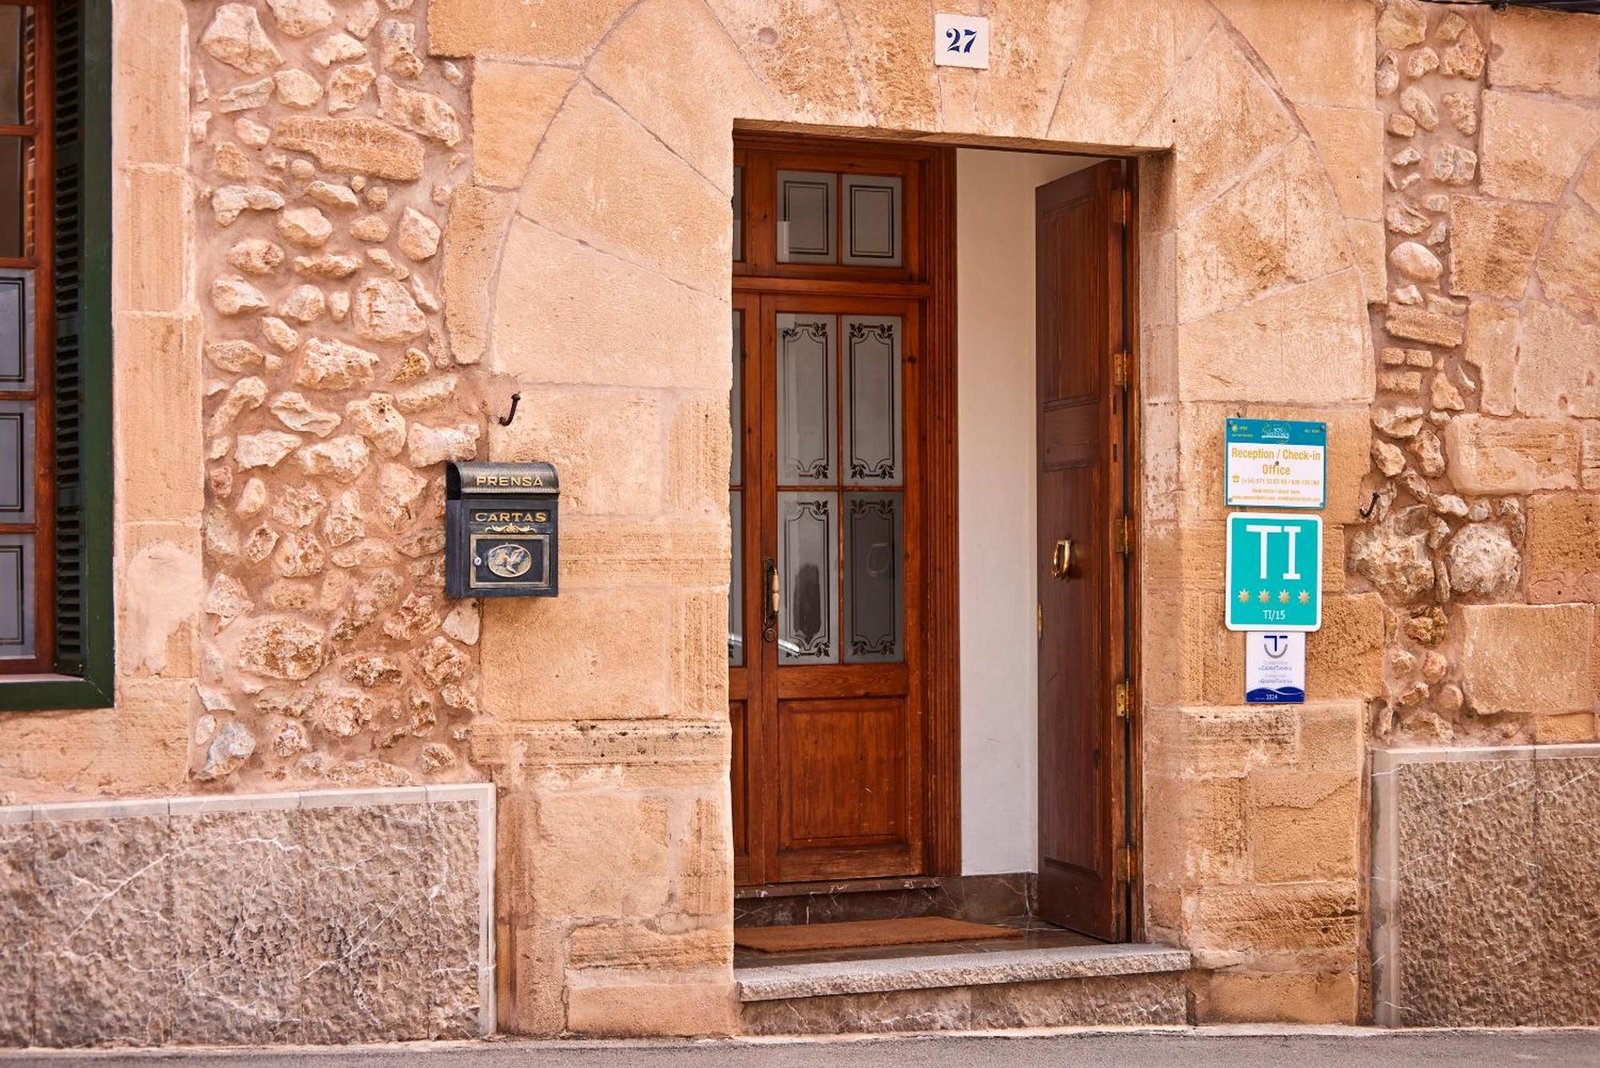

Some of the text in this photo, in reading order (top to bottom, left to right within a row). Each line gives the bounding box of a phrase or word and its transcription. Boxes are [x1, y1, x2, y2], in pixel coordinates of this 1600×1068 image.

[946, 28, 977, 53] 27
[1231, 448, 1321, 461] Reception / Check-in
[1262, 464, 1291, 476] Office
[476, 475, 544, 487] PRENSA
[475, 512, 547, 523] CARTAS
[1246, 524, 1302, 581] TI
[1263, 609, 1286, 621] TI/15
